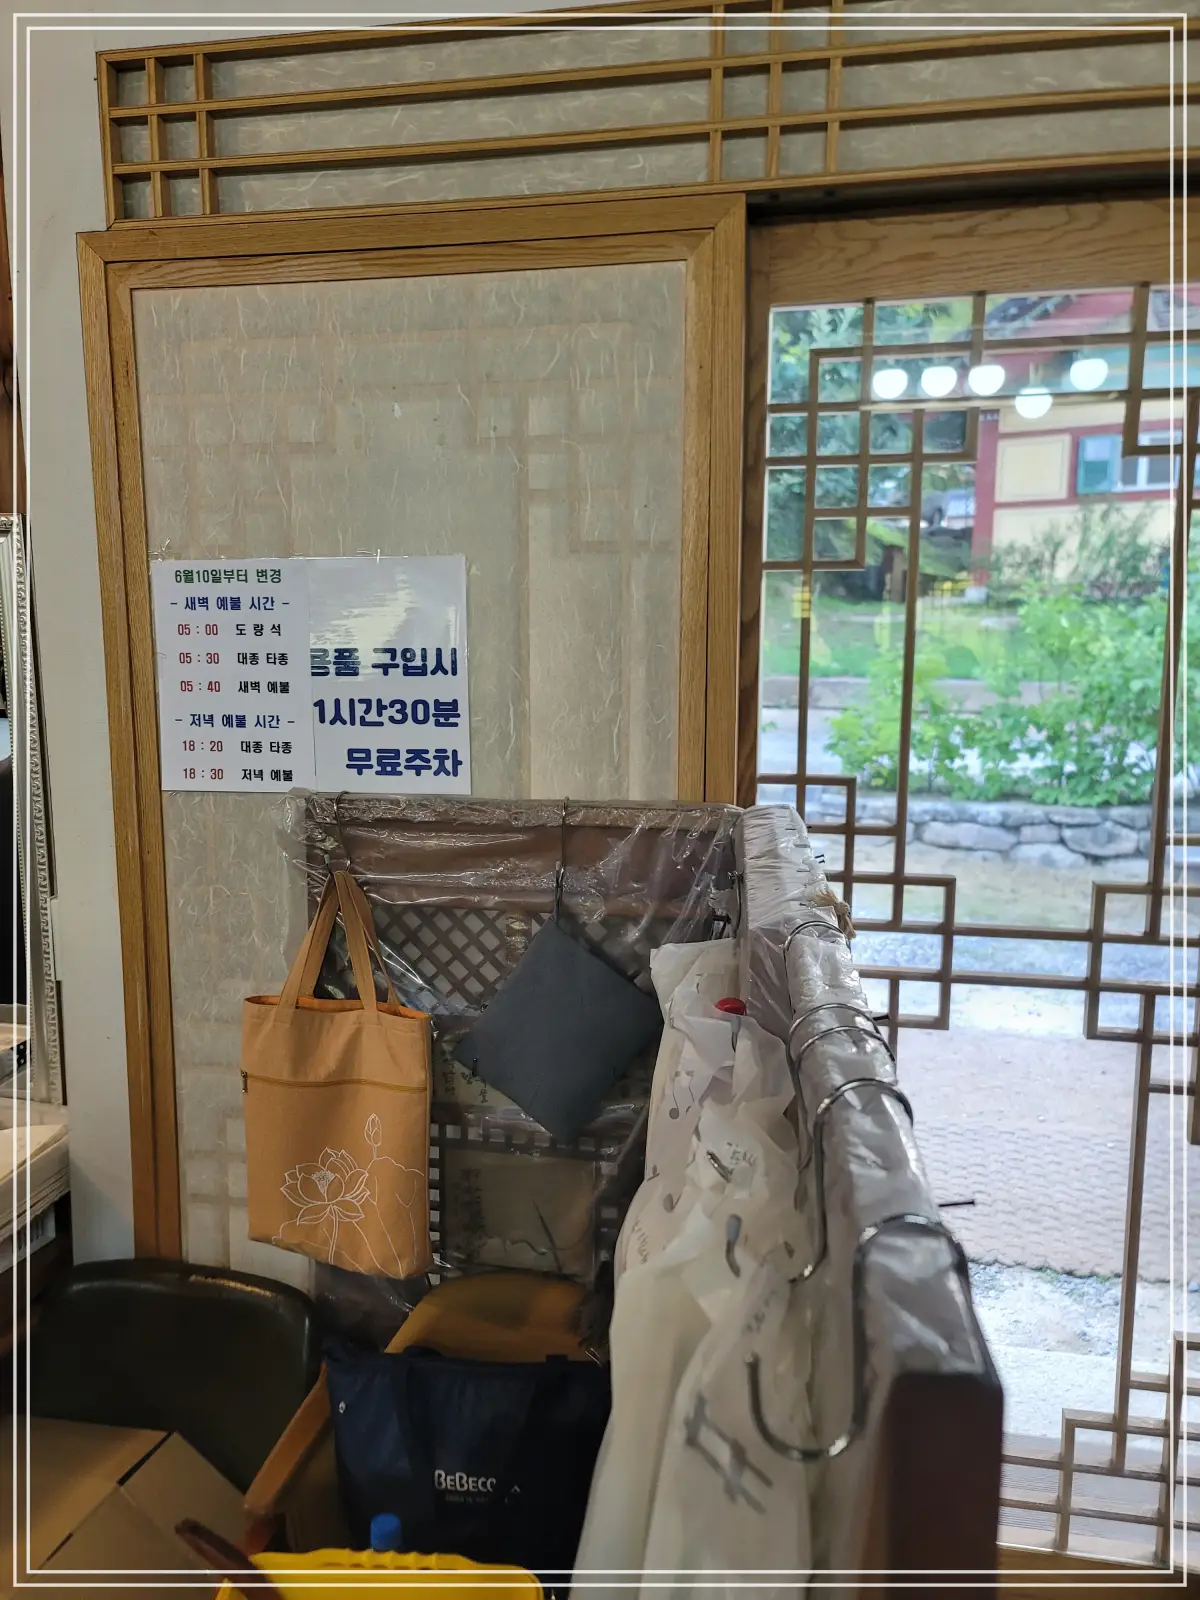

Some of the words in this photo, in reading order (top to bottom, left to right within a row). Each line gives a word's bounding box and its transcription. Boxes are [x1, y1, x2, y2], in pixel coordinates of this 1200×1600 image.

[174, 568, 248, 584] 6월10일부터
[256, 568, 282, 584] 변경
[184, 596, 209, 611] 새벽
[216, 596, 242, 611] 예불
[248, 596, 276, 611] 시간
[237, 652, 260, 666] 대종
[266, 652, 289, 666] 타종
[372, 648, 457, 676] 구입시
[237, 680, 261, 694] 새벽
[266, 681, 290, 694] 예불
[313, 698, 460, 727] 1시간30분
[189, 713, 215, 728] 저녁
[221, 713, 247, 729] 예불
[254, 714, 281, 729] 시간
[240, 740, 263, 754] 대종
[269, 741, 293, 755] 타종
[346, 748, 462, 777] 무료주차
[241, 768, 264, 782] 저녁
[270, 769, 293, 782] 예불
